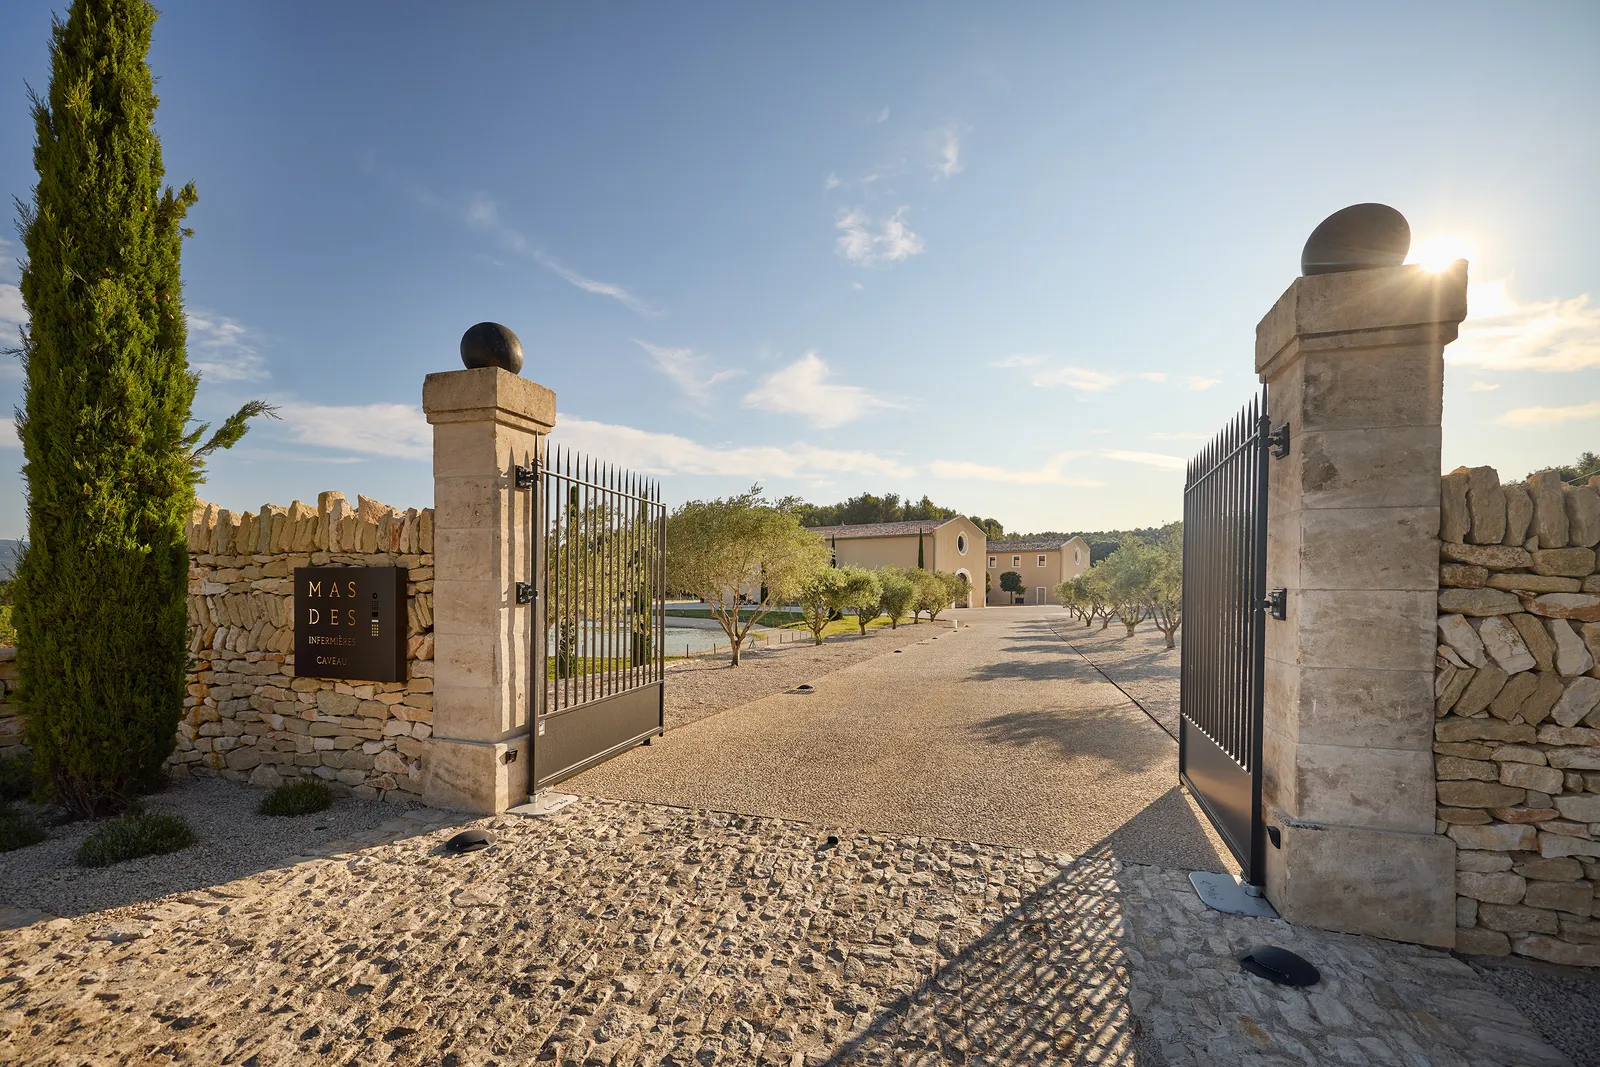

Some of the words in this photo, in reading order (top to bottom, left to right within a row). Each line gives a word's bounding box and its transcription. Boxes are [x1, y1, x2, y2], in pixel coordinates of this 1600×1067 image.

[308, 581, 356, 598] MAS
[308, 608, 356, 626] DES
[316, 656, 347, 666] CAVEAU
